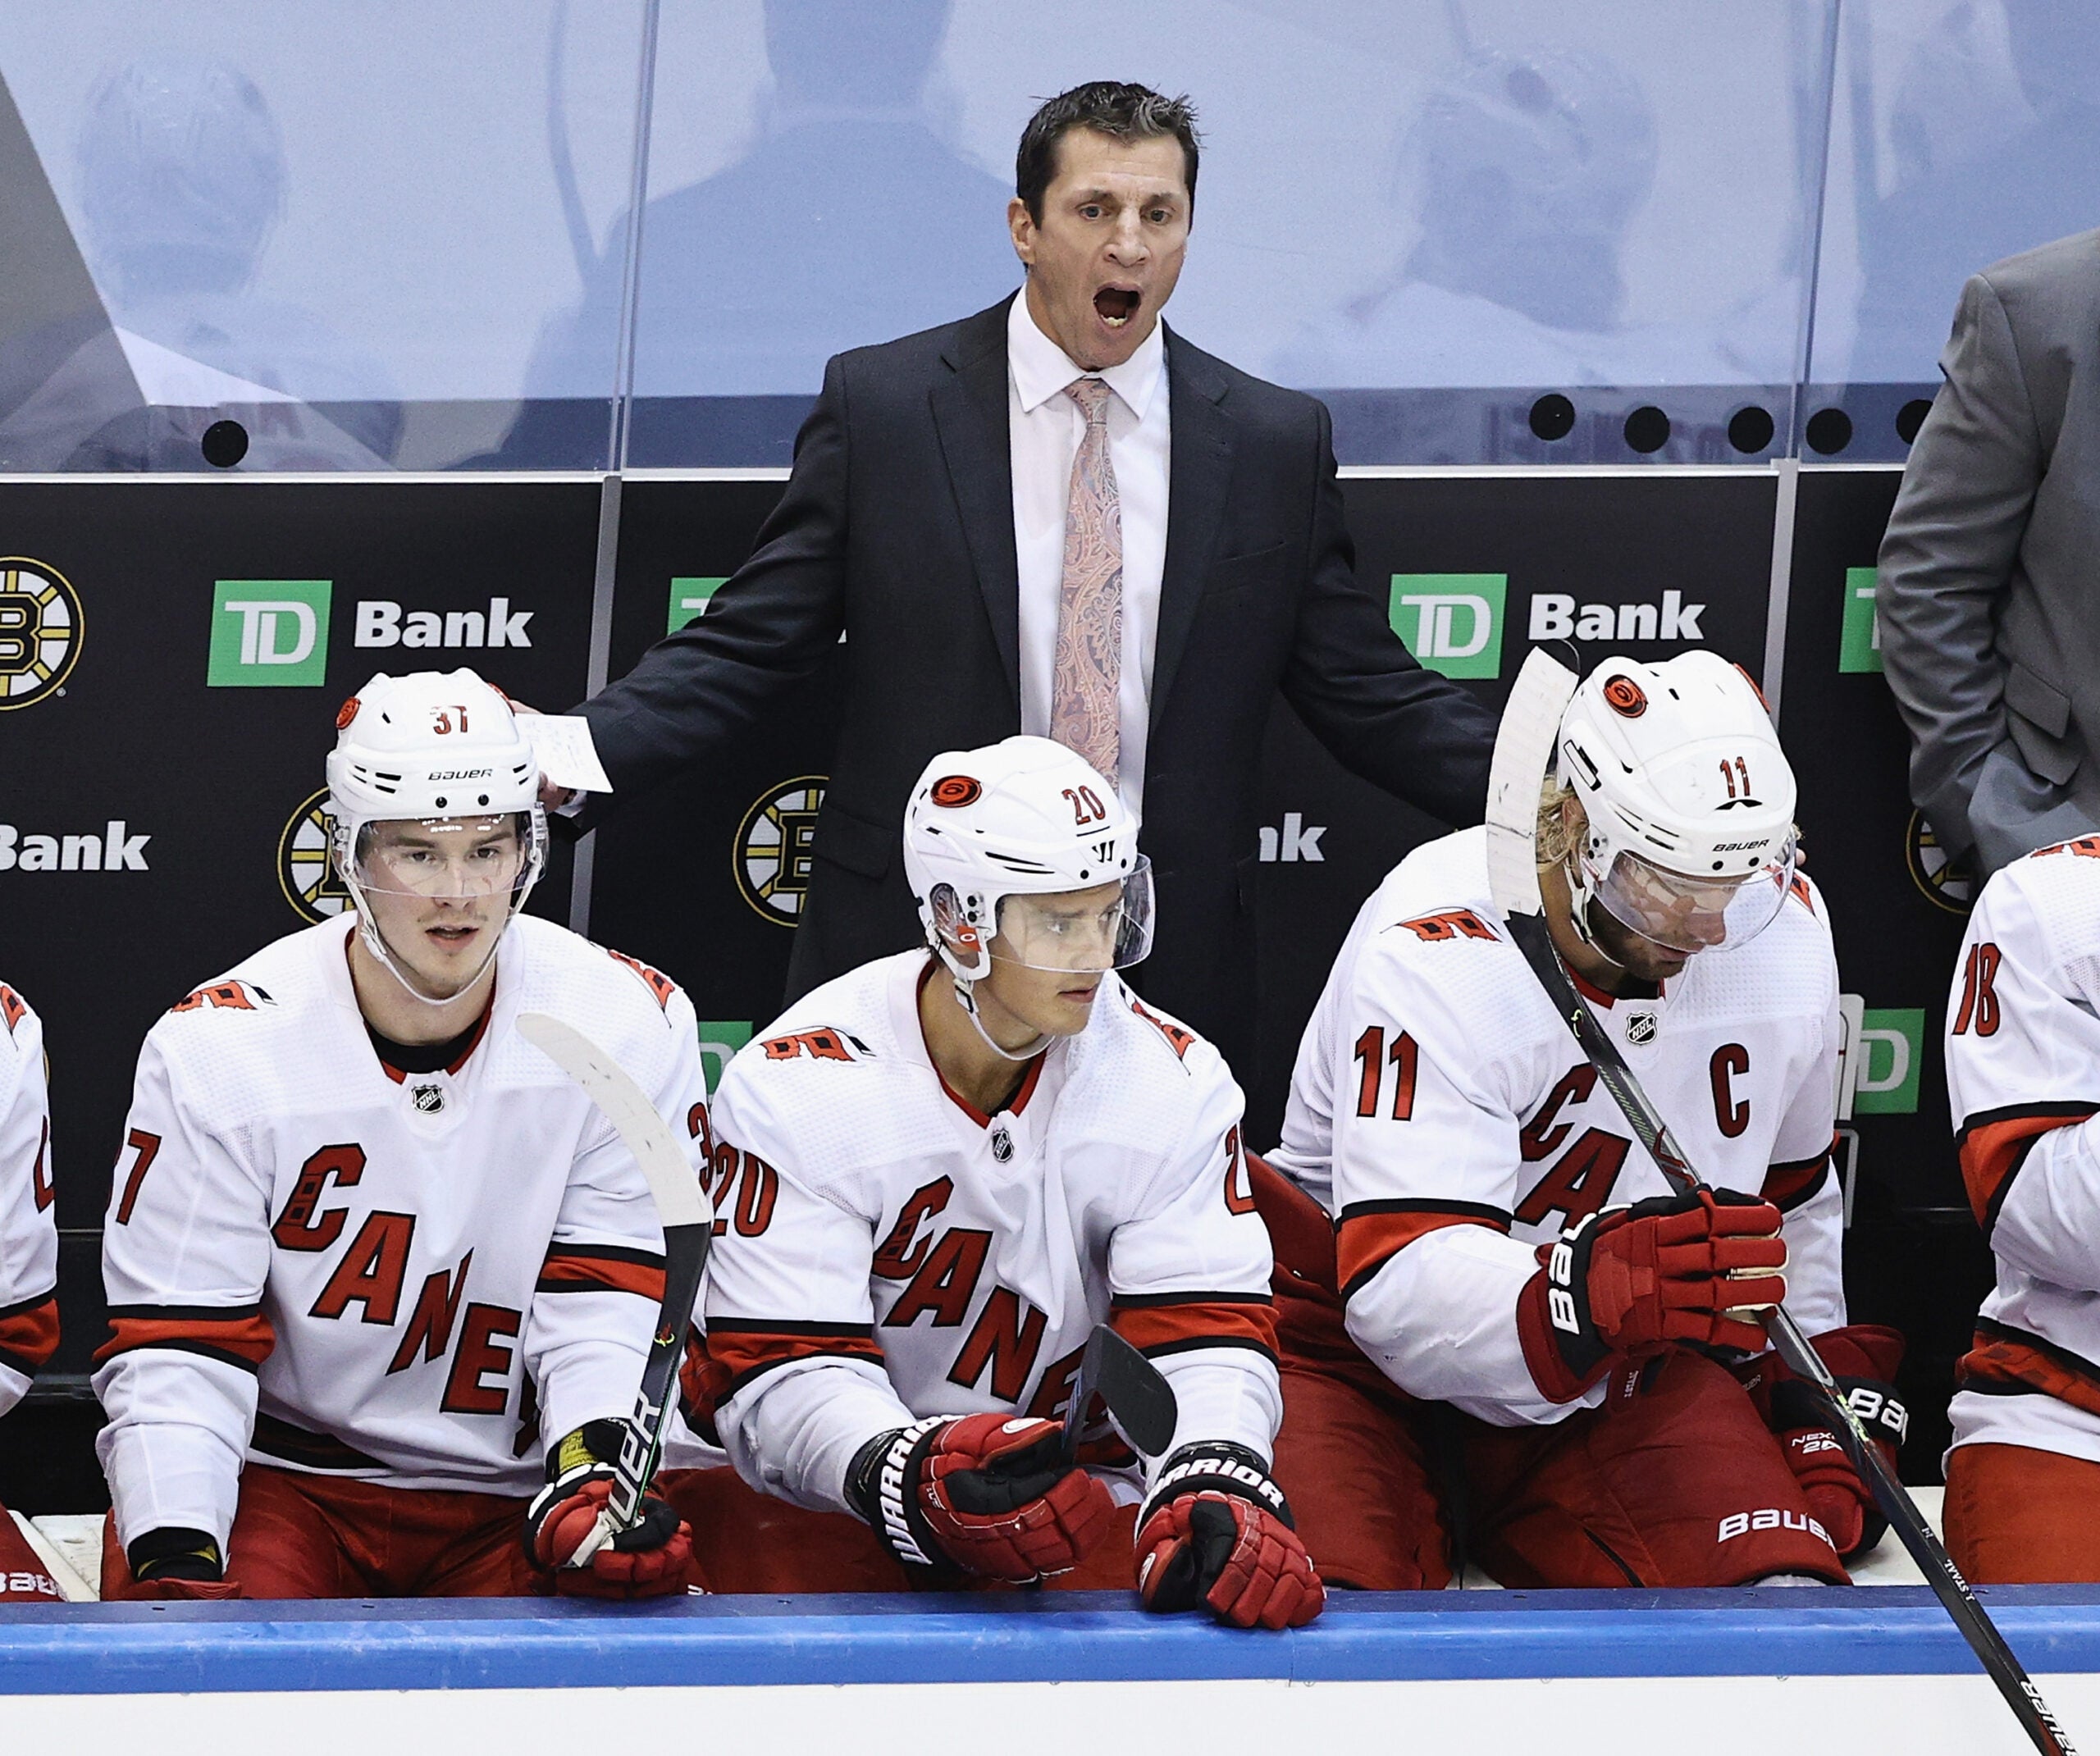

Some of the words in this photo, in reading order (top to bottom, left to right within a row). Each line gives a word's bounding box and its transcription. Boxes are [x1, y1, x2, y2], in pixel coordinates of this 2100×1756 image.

[224, 600, 317, 665] TD
[354, 597, 534, 648] Bank
[1400, 594, 1492, 658] TD
[1527, 590, 1706, 641] Bank
[1061, 785, 1106, 826] 20
[1719, 755, 1751, 799] 11
[1354, 1024, 1419, 1122] 11
[1709, 1042, 1751, 1138] C
[108, 1127, 162, 1226] 7
[710, 1140, 780, 1238] 20
